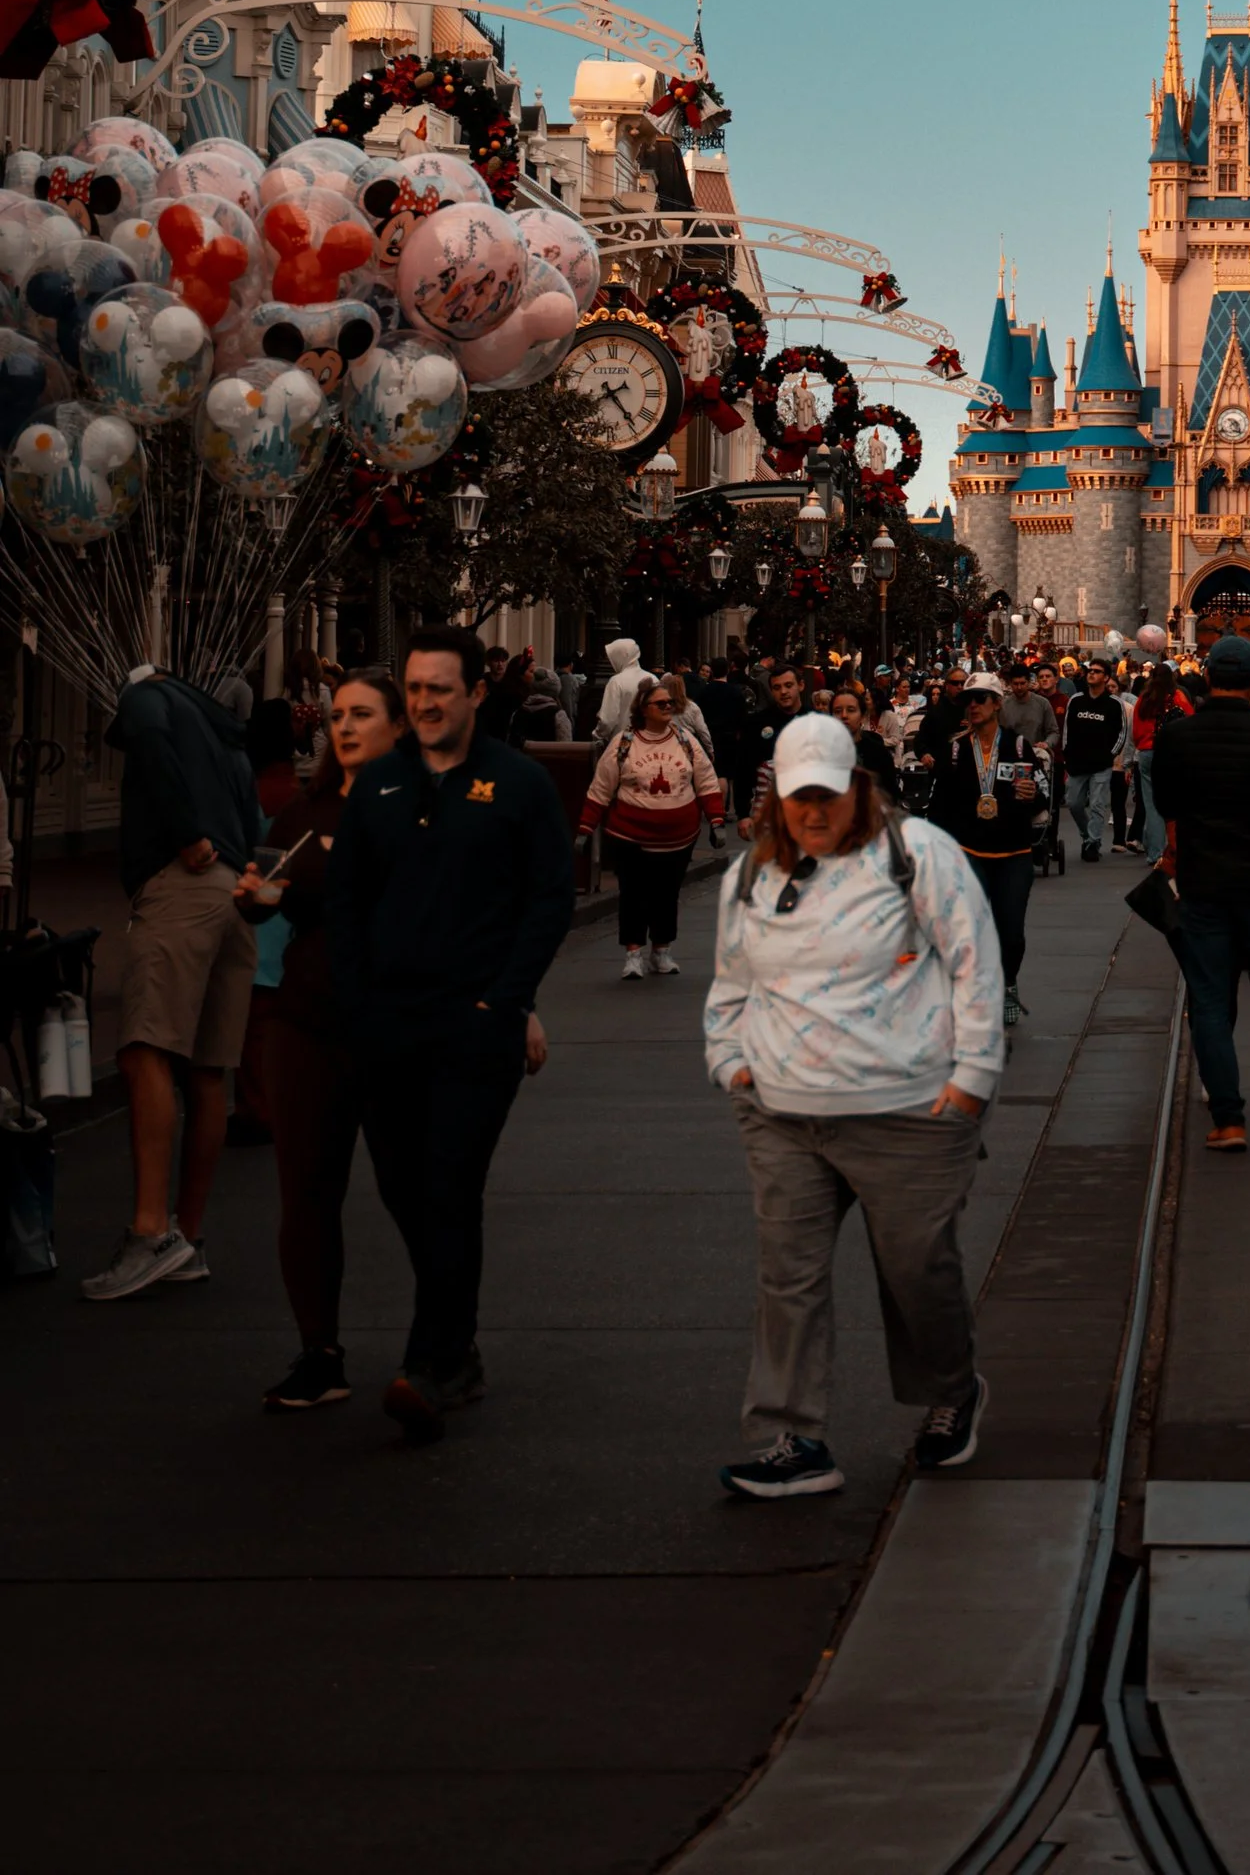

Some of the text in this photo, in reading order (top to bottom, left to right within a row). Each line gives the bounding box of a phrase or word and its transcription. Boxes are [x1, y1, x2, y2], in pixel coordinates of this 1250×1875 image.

[593, 366, 630, 375] CITIZEN
[1076, 710, 1105, 722] adidas
[635, 752, 674, 768] DISNEY
